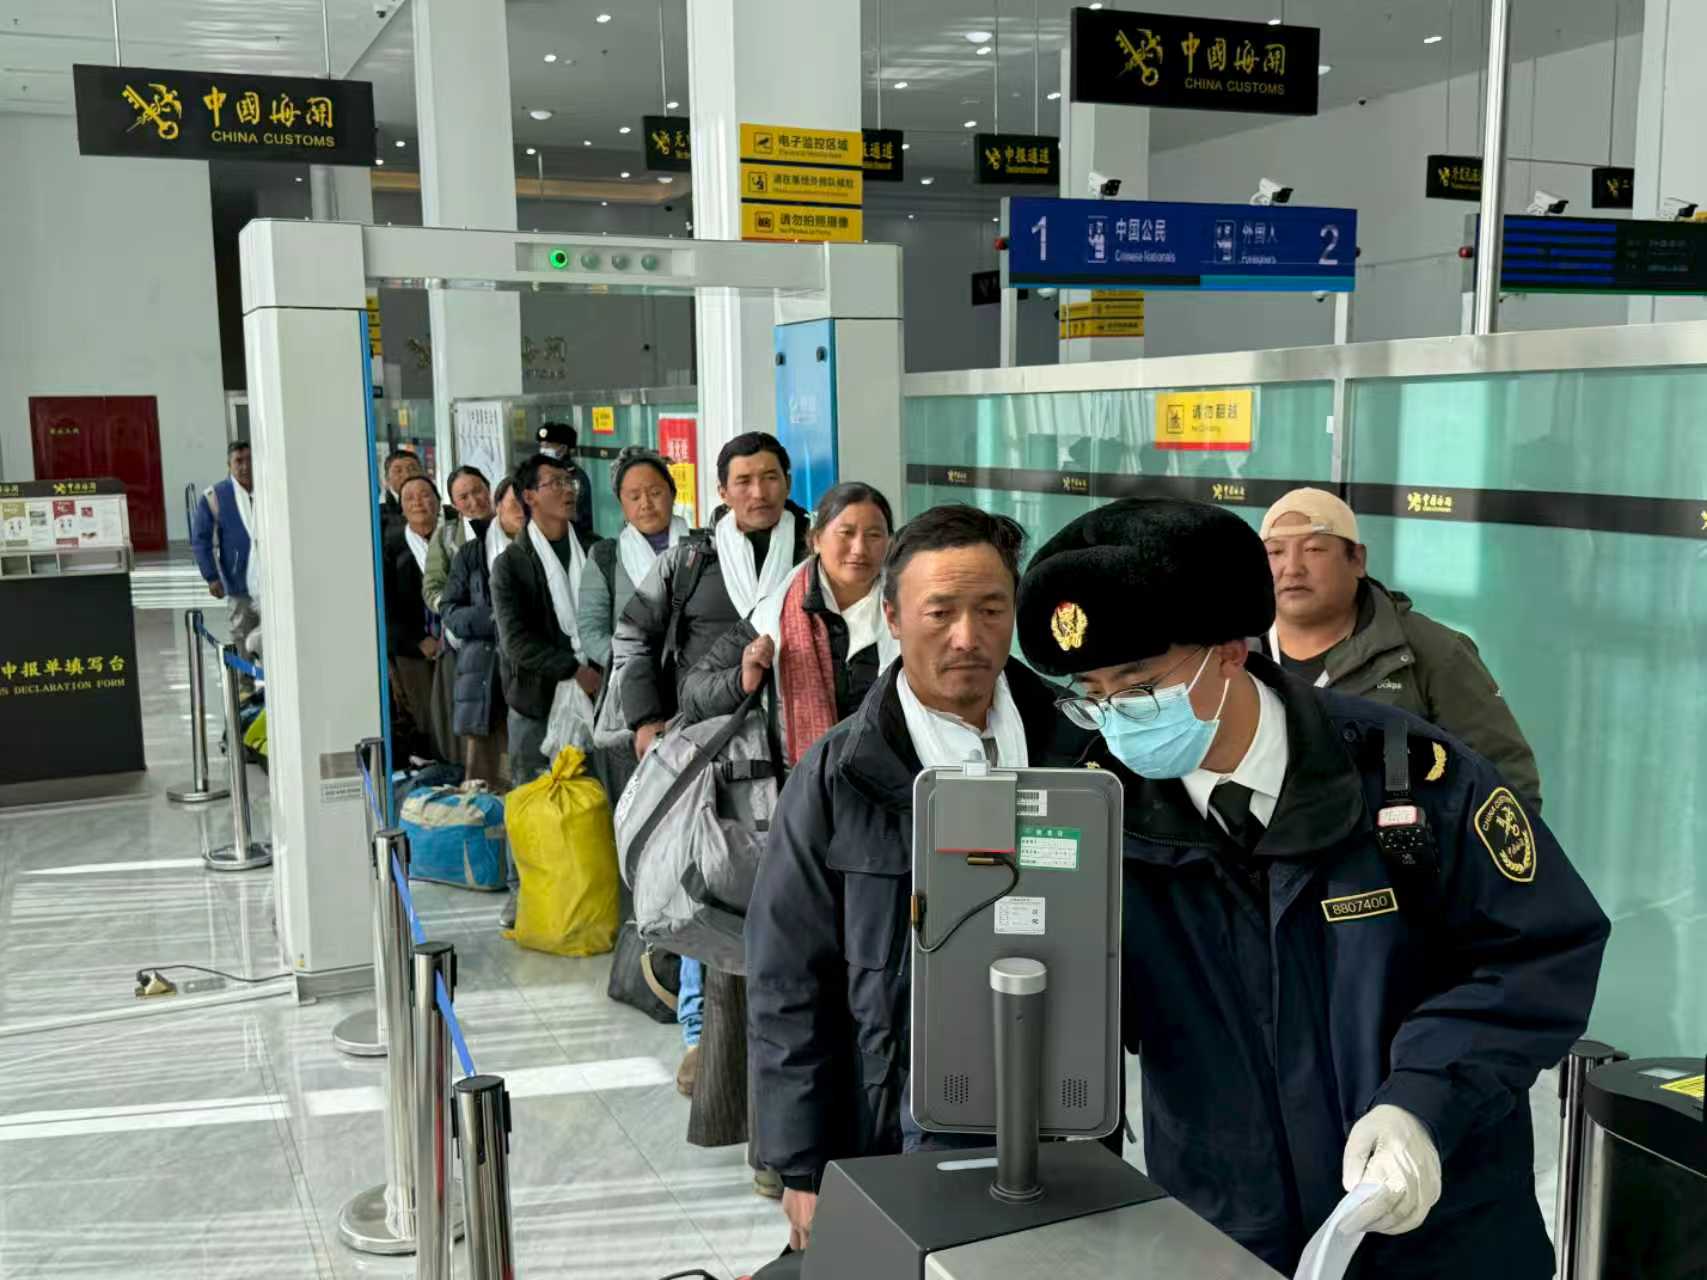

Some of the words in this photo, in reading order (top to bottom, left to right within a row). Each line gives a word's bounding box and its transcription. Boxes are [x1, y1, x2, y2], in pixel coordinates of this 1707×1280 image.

[1184, 77, 1223, 91] CHINA
[1226, 80, 1285, 95] CUSTOMS
[211, 130, 258, 144] CHINA
[263, 132, 335, 147] CUSTOMS
[1031, 215, 1047, 261] 1
[1115, 217, 1166, 243] 中国公民
[1319, 224, 1339, 265] 2
[14, 680, 92, 696] DECLARATION
[96, 677, 126, 689] FORM
